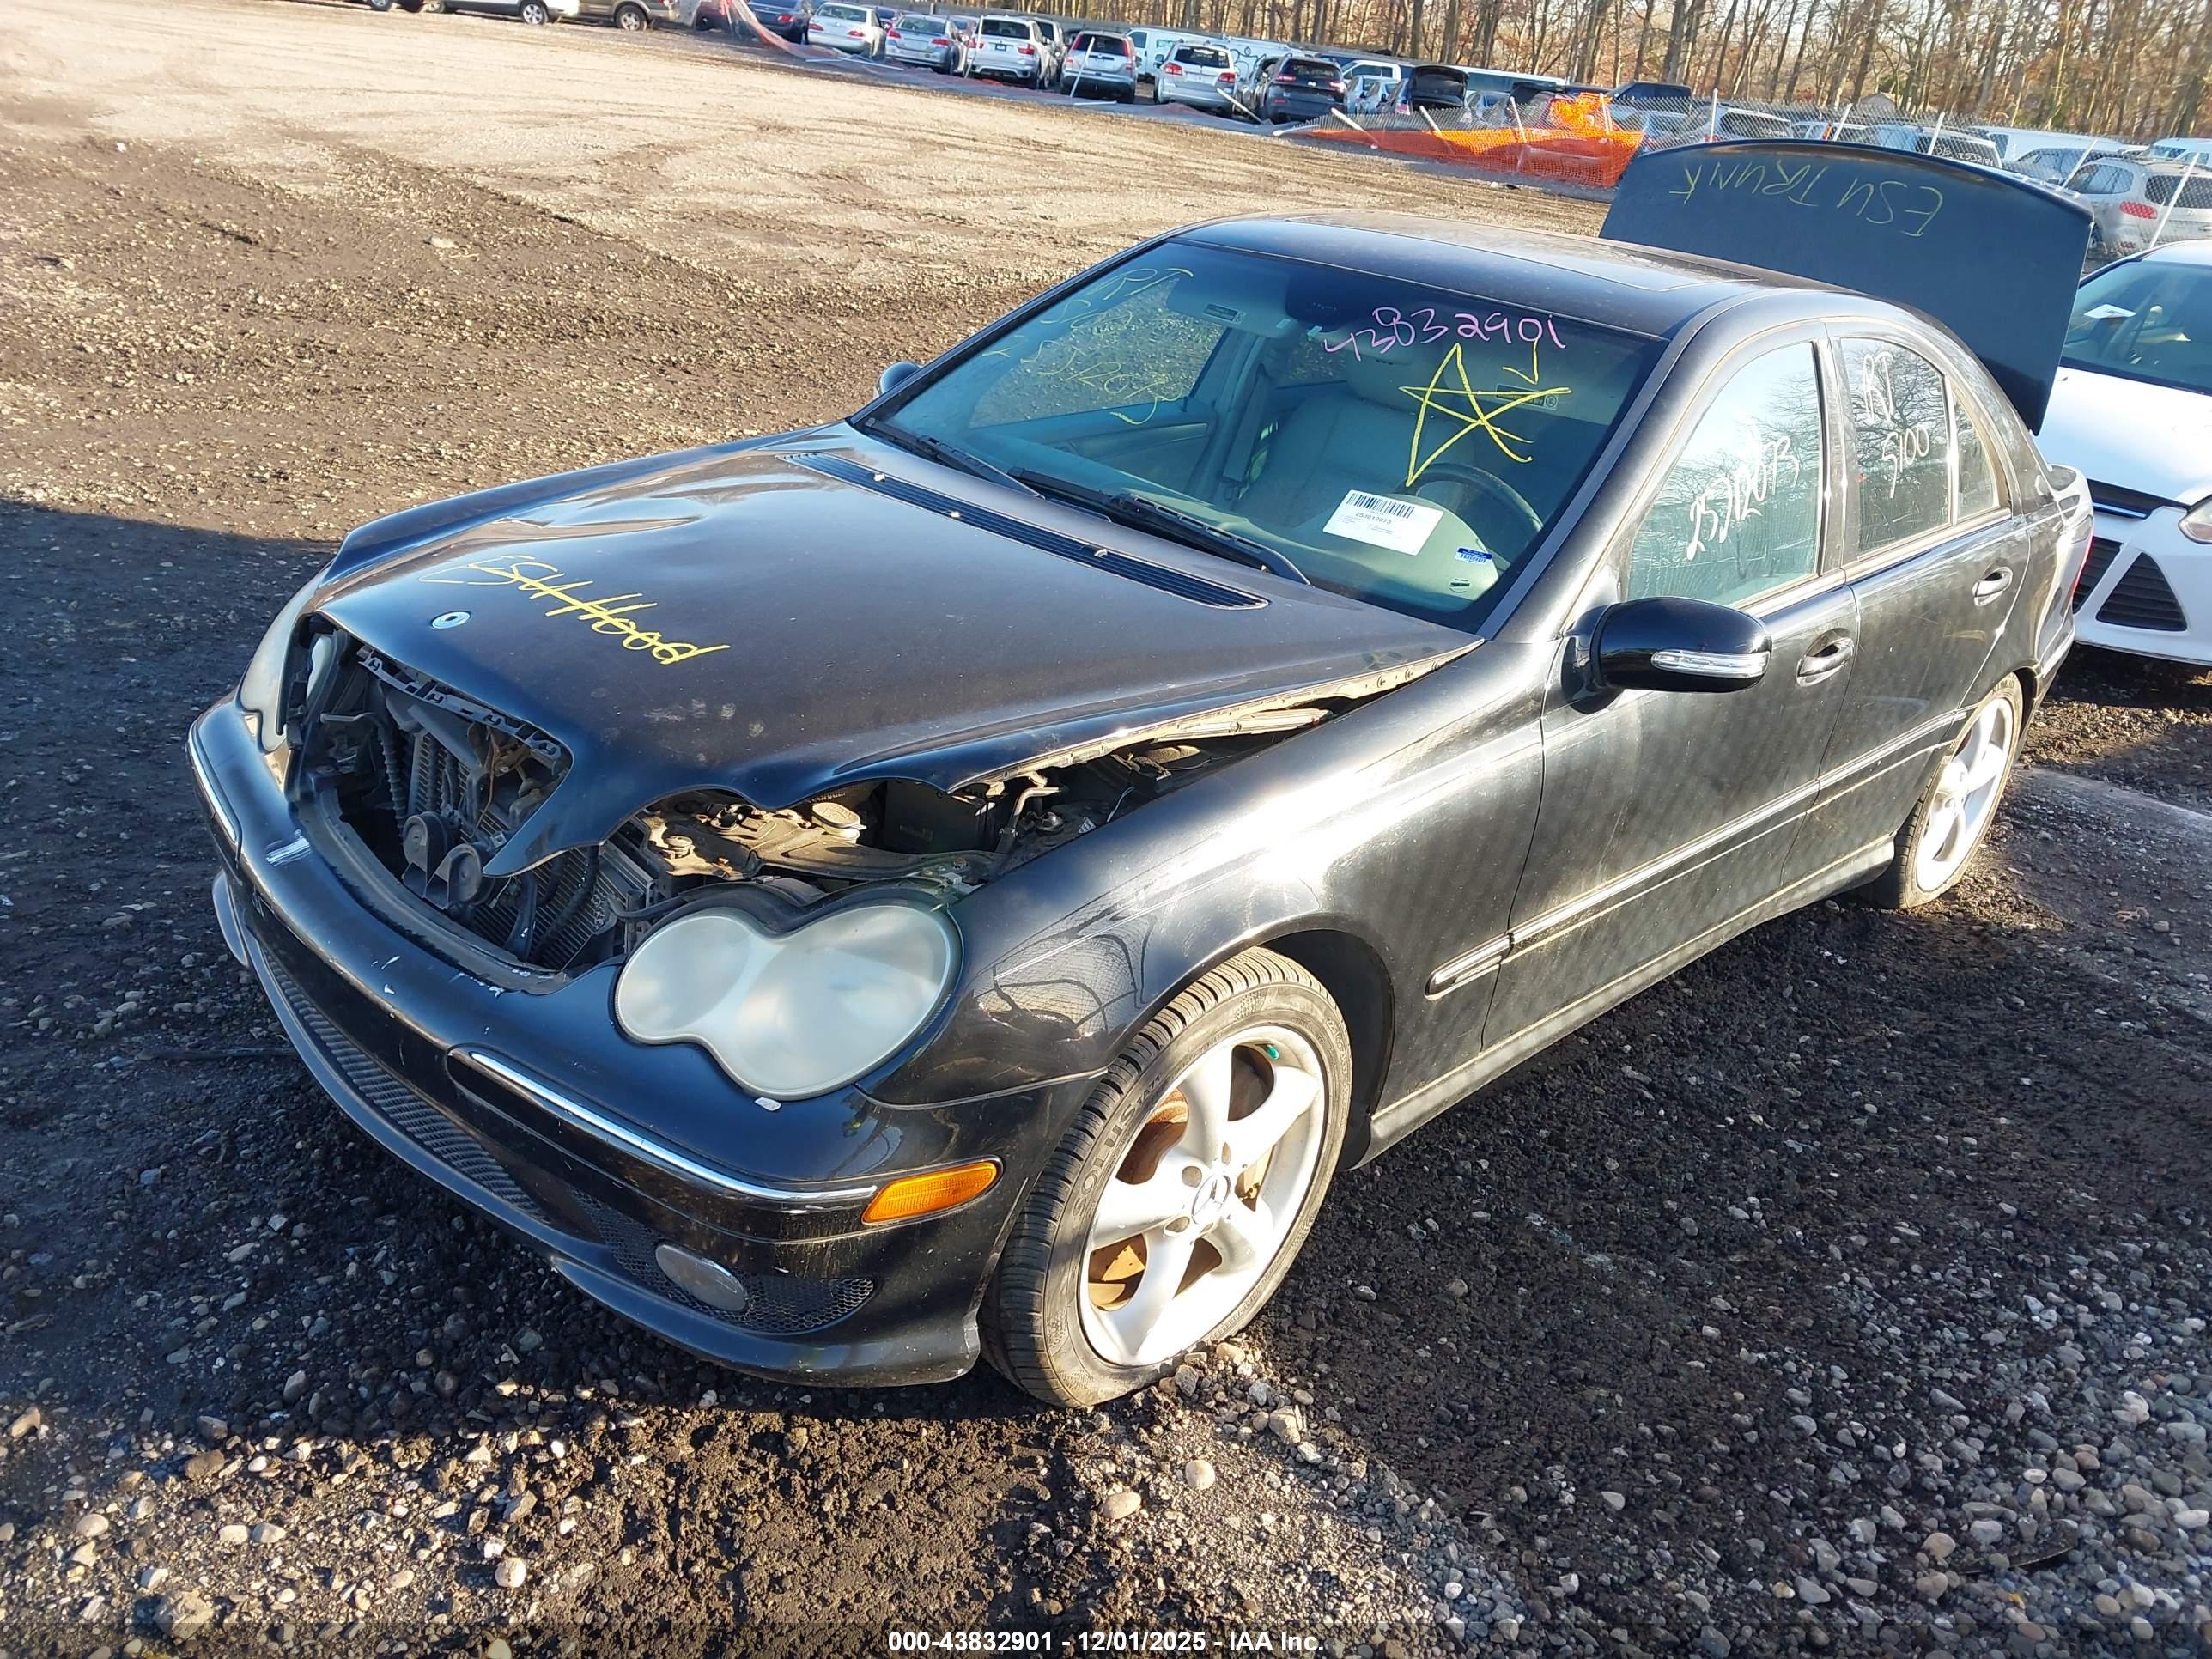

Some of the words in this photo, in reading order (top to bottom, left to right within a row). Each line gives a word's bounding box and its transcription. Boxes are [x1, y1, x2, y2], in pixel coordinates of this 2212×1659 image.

[1668, 159, 1829, 207] TRUNK
[1836, 179, 1943, 237] ESU
[1323, 307, 1566, 362] 43832901
[545, 592, 731, 665] Hood
[1072, 1103, 1136, 1218] SOLUS
